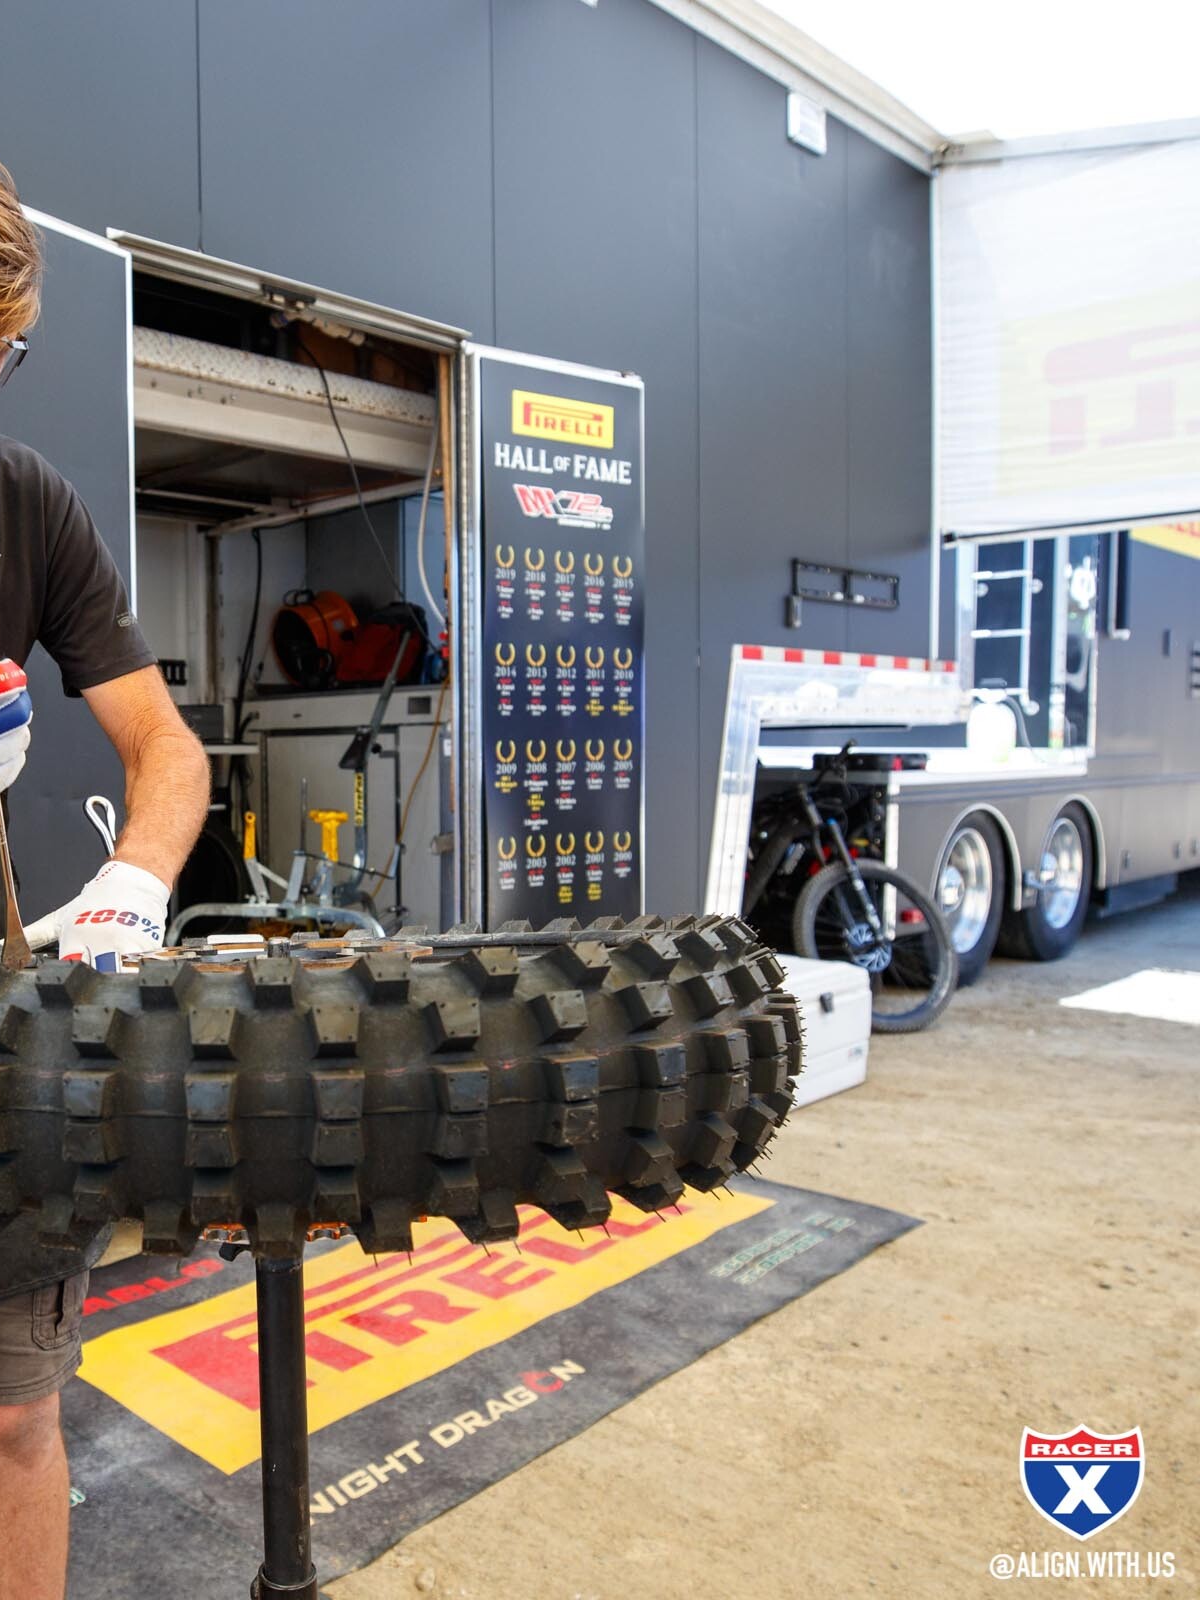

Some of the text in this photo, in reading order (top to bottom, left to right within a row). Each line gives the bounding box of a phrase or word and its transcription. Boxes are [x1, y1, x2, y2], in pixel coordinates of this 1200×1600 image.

[522, 401, 604, 438] PIRELLI
[494, 441, 632, 485] HALL OF FAME
[495, 568, 634, 589] 2019 2018 2017 2016 2015
[495, 666, 634, 679] 2014 2013 2012 2011 2010
[496, 760, 633, 775] 2009 2008 2007 2006 2005
[498, 852, 632, 872] 2004 2003 2002 2001 2000
[74, 909, 161, 941] 100%
[82, 1258, 224, 1317] ABLO
[149, 1185, 693, 1412] PIRELL
[309, 1359, 586, 1526] NIGHT DRAGON
